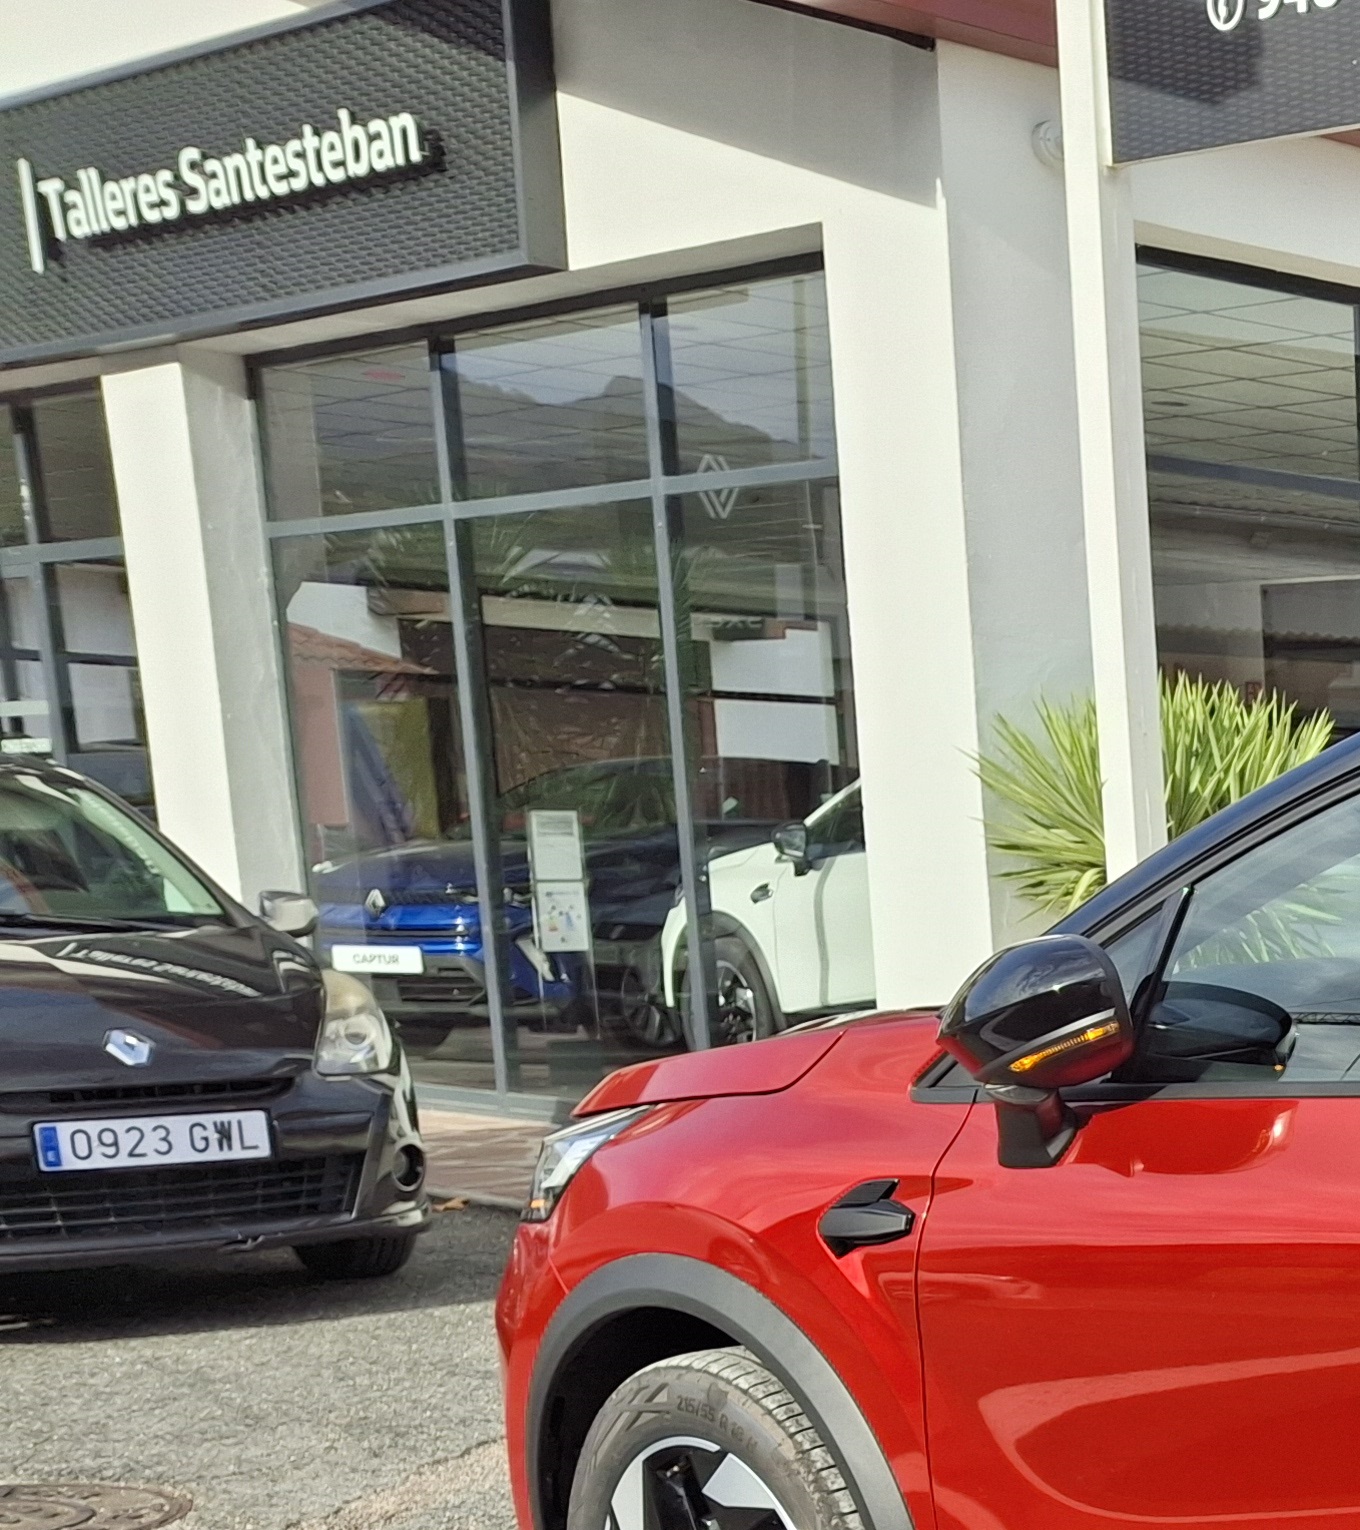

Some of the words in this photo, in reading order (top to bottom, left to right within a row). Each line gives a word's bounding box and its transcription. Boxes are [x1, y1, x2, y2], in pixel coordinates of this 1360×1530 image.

[37, 167, 180, 242] Talleres
[177, 107, 422, 214] Santesteban
[352, 953, 400, 965] CAPTUR
[69, 1124, 173, 1161] 0923
[188, 1119, 260, 1154] GWL
